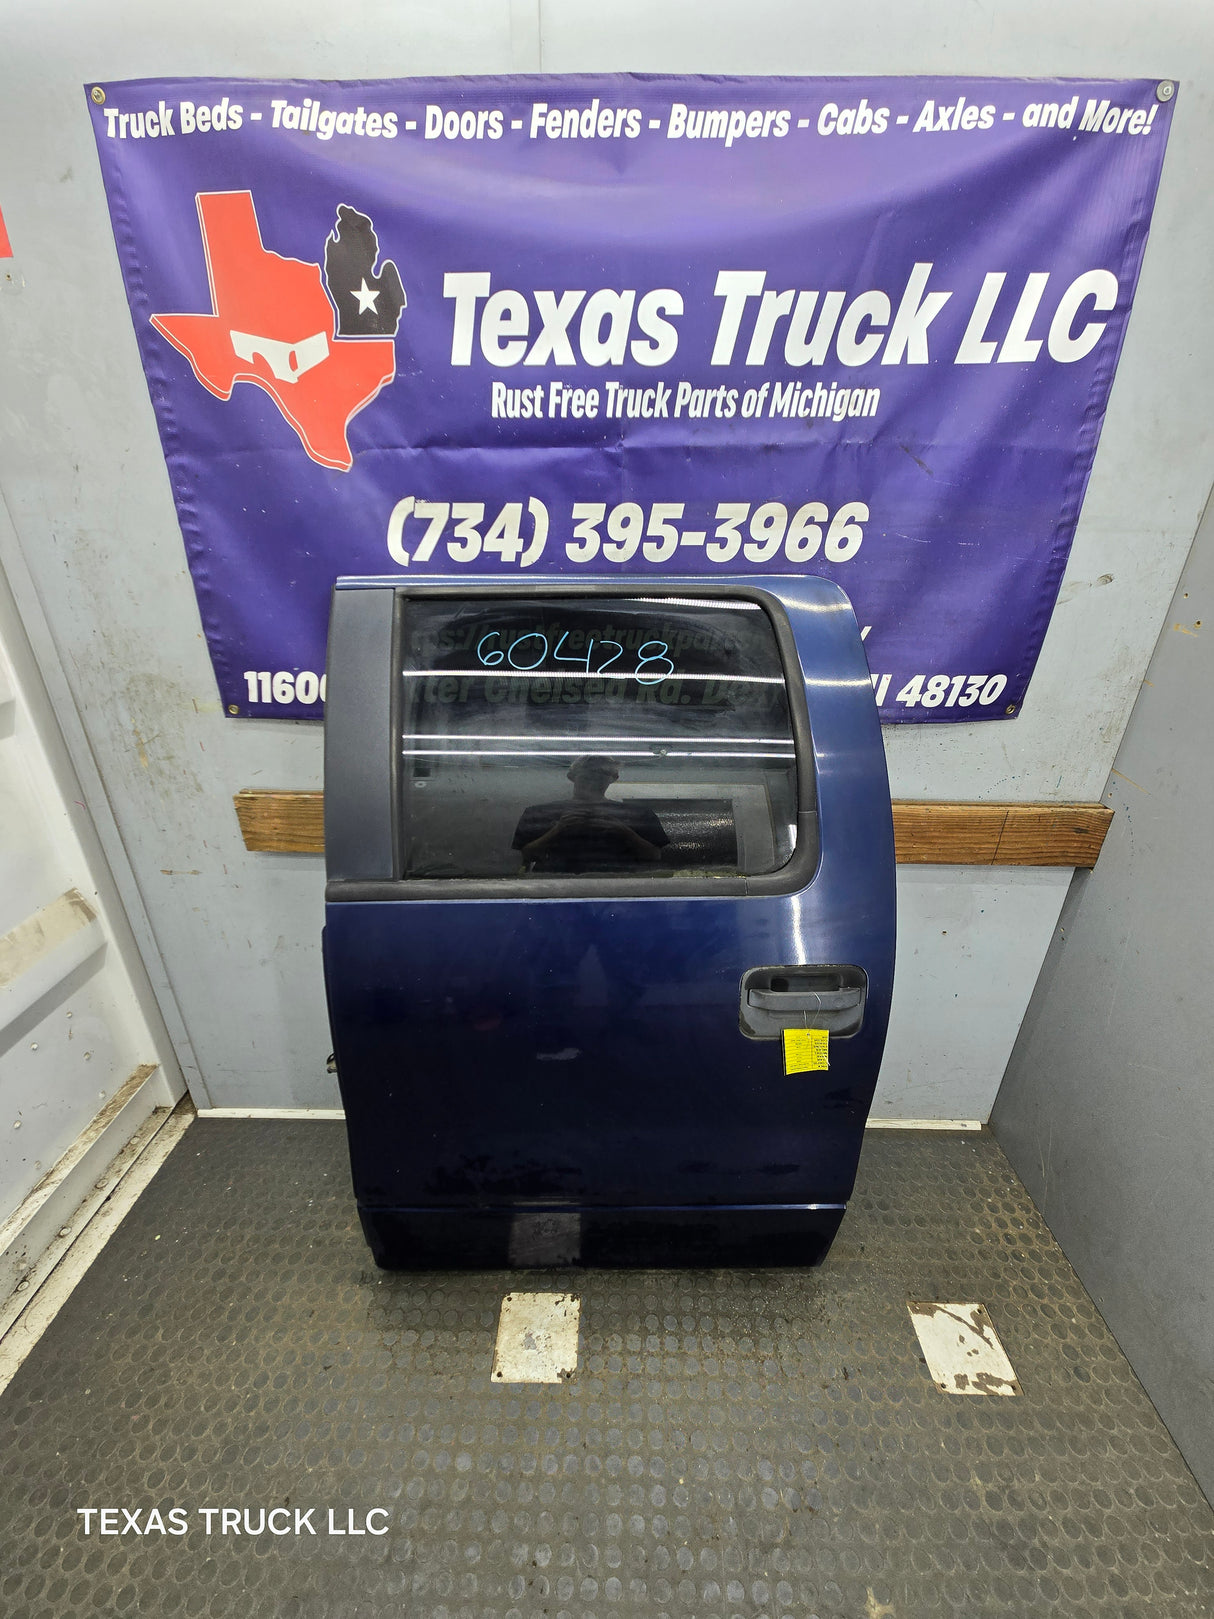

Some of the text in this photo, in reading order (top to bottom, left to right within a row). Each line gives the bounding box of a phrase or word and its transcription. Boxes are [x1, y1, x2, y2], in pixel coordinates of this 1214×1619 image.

[103, 100, 175, 139] Truck
[181, 97, 243, 135] Beds
[270, 98, 399, 141] Tailgates
[424, 104, 504, 140] Doors
[529, 98, 643, 139] Fenders
[666, 103, 792, 148] Bumpers
[816, 98, 891, 137] Cabs
[911, 96, 997, 133] Axles
[1021, 95, 1079, 129] and
[1078, 98, 1160, 136] More!
[442, 262, 1119, 367] Texas Truck LLC
[491, 380, 881, 422] Rust Free Truck Parts of Michigan
[387, 495, 870, 568] (734) 395-3966
[477, 630, 675, 685] 60428
[895, 673, 1008, 708] 48130
